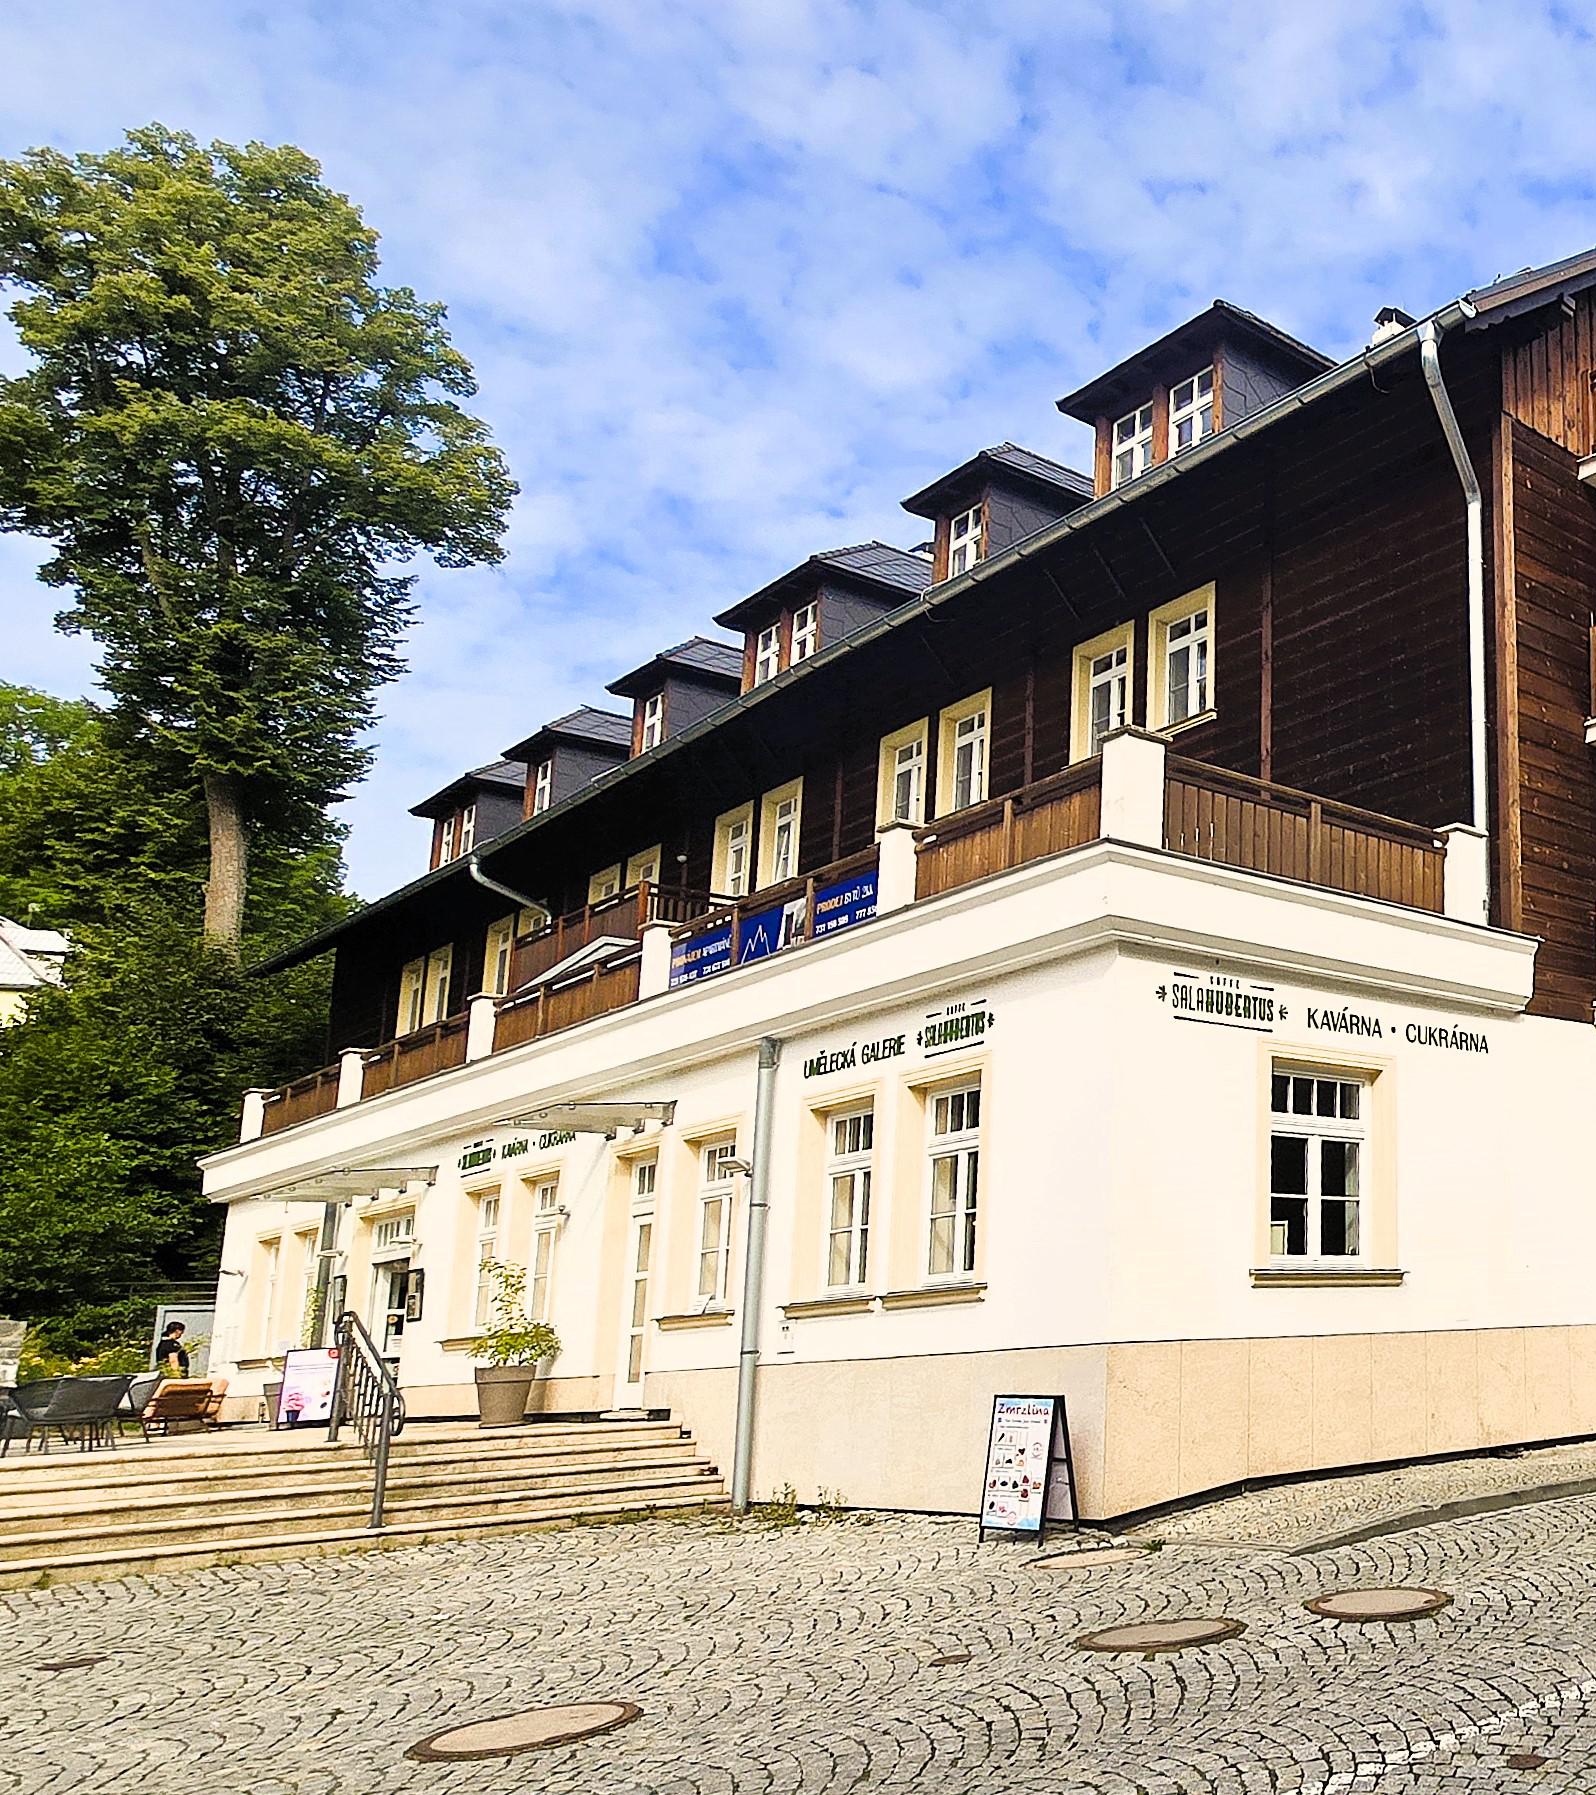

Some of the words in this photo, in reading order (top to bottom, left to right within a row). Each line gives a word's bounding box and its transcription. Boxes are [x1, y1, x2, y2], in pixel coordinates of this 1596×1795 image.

[1172, 983, 1274, 1022] SALAHUBERTUS
[1307, 1007, 1383, 1039] KAVÁRNA
[1405, 1023, 1489, 1054] CUKRÁRNA
[803, 1041, 857, 1079] UMĚLECKÁ
[861, 1034, 906, 1065] GALERIE
[996, 1403, 1050, 1417] Zmrzlina
